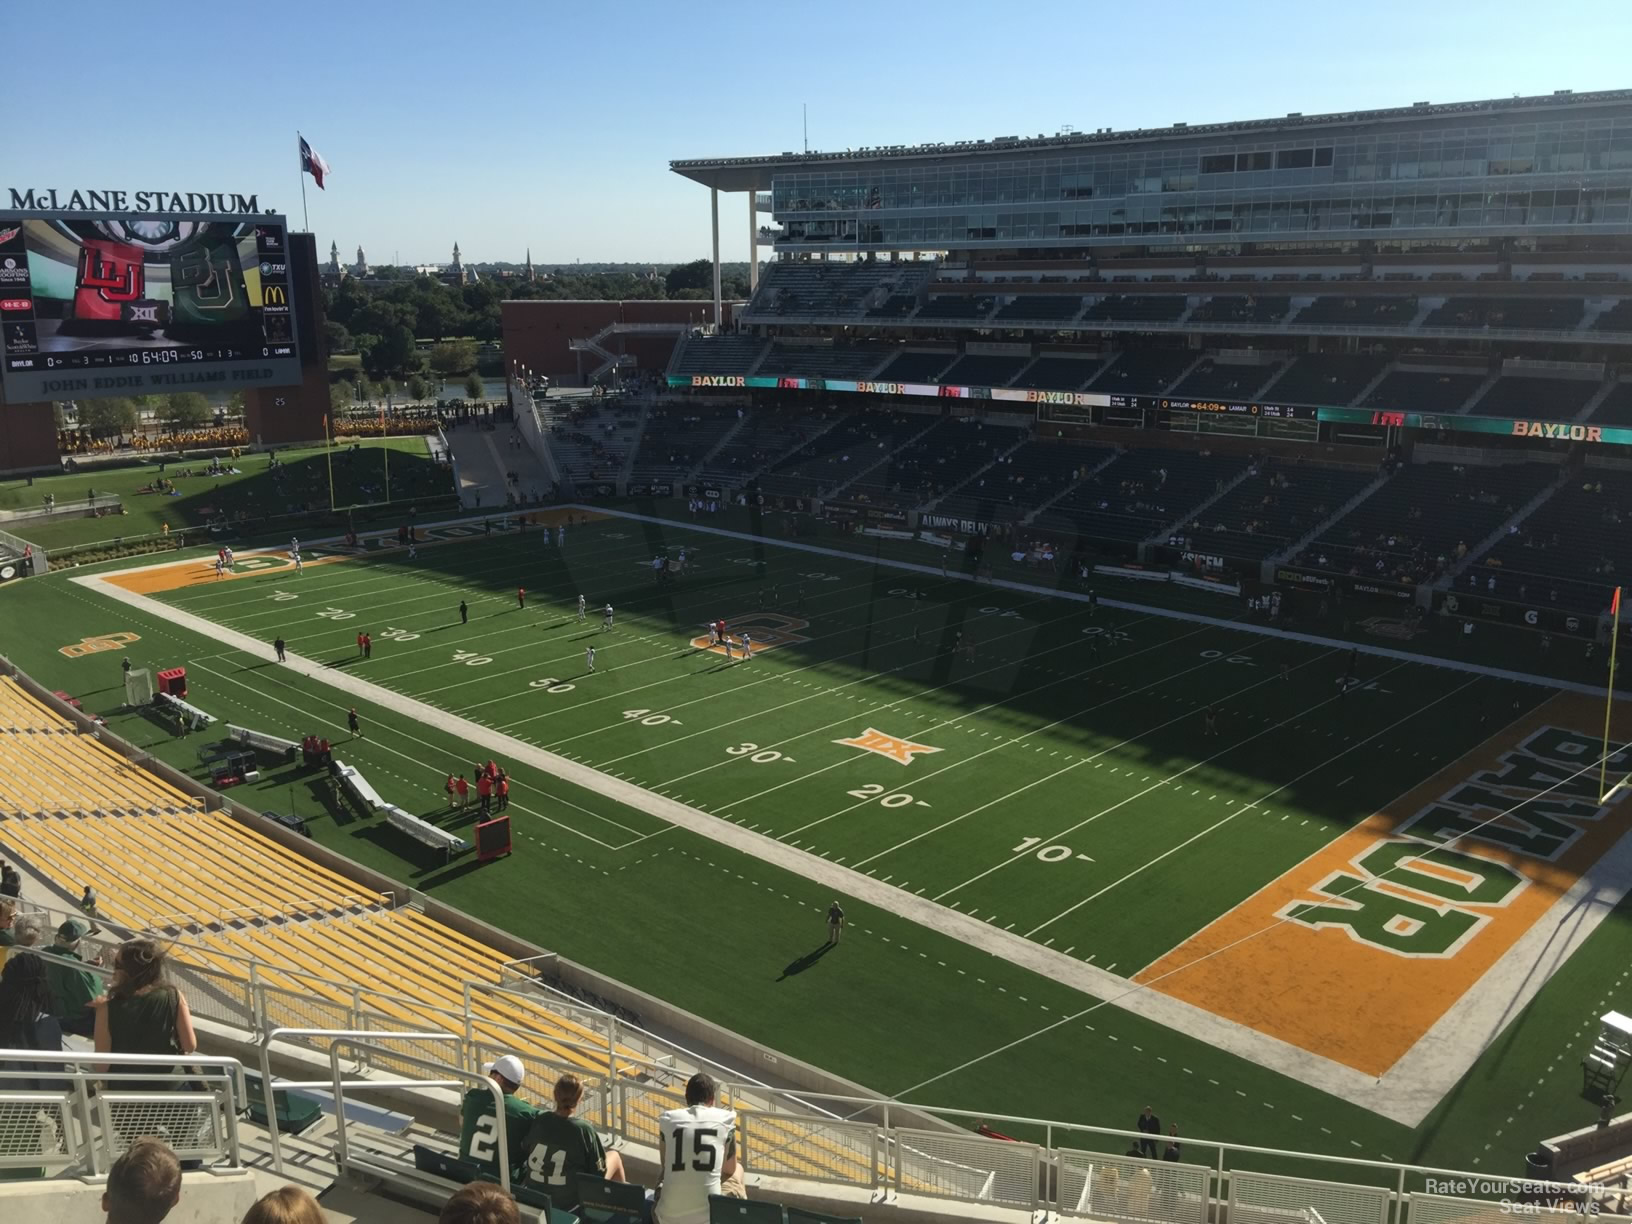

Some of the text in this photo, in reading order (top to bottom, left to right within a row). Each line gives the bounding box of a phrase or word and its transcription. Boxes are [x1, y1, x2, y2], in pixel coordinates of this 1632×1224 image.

[8, 188, 259, 214] McLANE STADIUM
[47, 357, 54, 367] 0
[83, 356, 89, 364] 3
[129, 353, 138, 363] 10
[142, 350, 178, 364] 64:09
[191, 350, 203, 360] 50
[262, 347, 269, 356] 0
[42, 368, 273, 395] JOHN EDDIE WILLIAMS FIELD
[692, 376, 745, 387] BAYLOR
[856, 380, 905, 394] BAYLOR
[1027, 390, 1084, 405] BAYLOR
[1162, 400, 1168, 409] 0
[1197, 403, 1220, 412] 64:09
[1251, 406, 1258, 414] 0
[1512, 420, 1602, 442] BAYLOR
[922, 514, 959, 530] ALWAYS
[316, 608, 356, 620] 20
[380, 628, 421, 642] 30
[452, 651, 493, 666] 40
[529, 677, 576, 693] 50
[622, 708, 671, 726] 40
[725, 742, 783, 764] 30
[846, 783, 914, 808] 20
[1012, 836, 1073, 862] 10
[469, 1114, 498, 1162] 2
[671, 1127, 719, 1172] 15
[528, 1144, 567, 1186] 41
